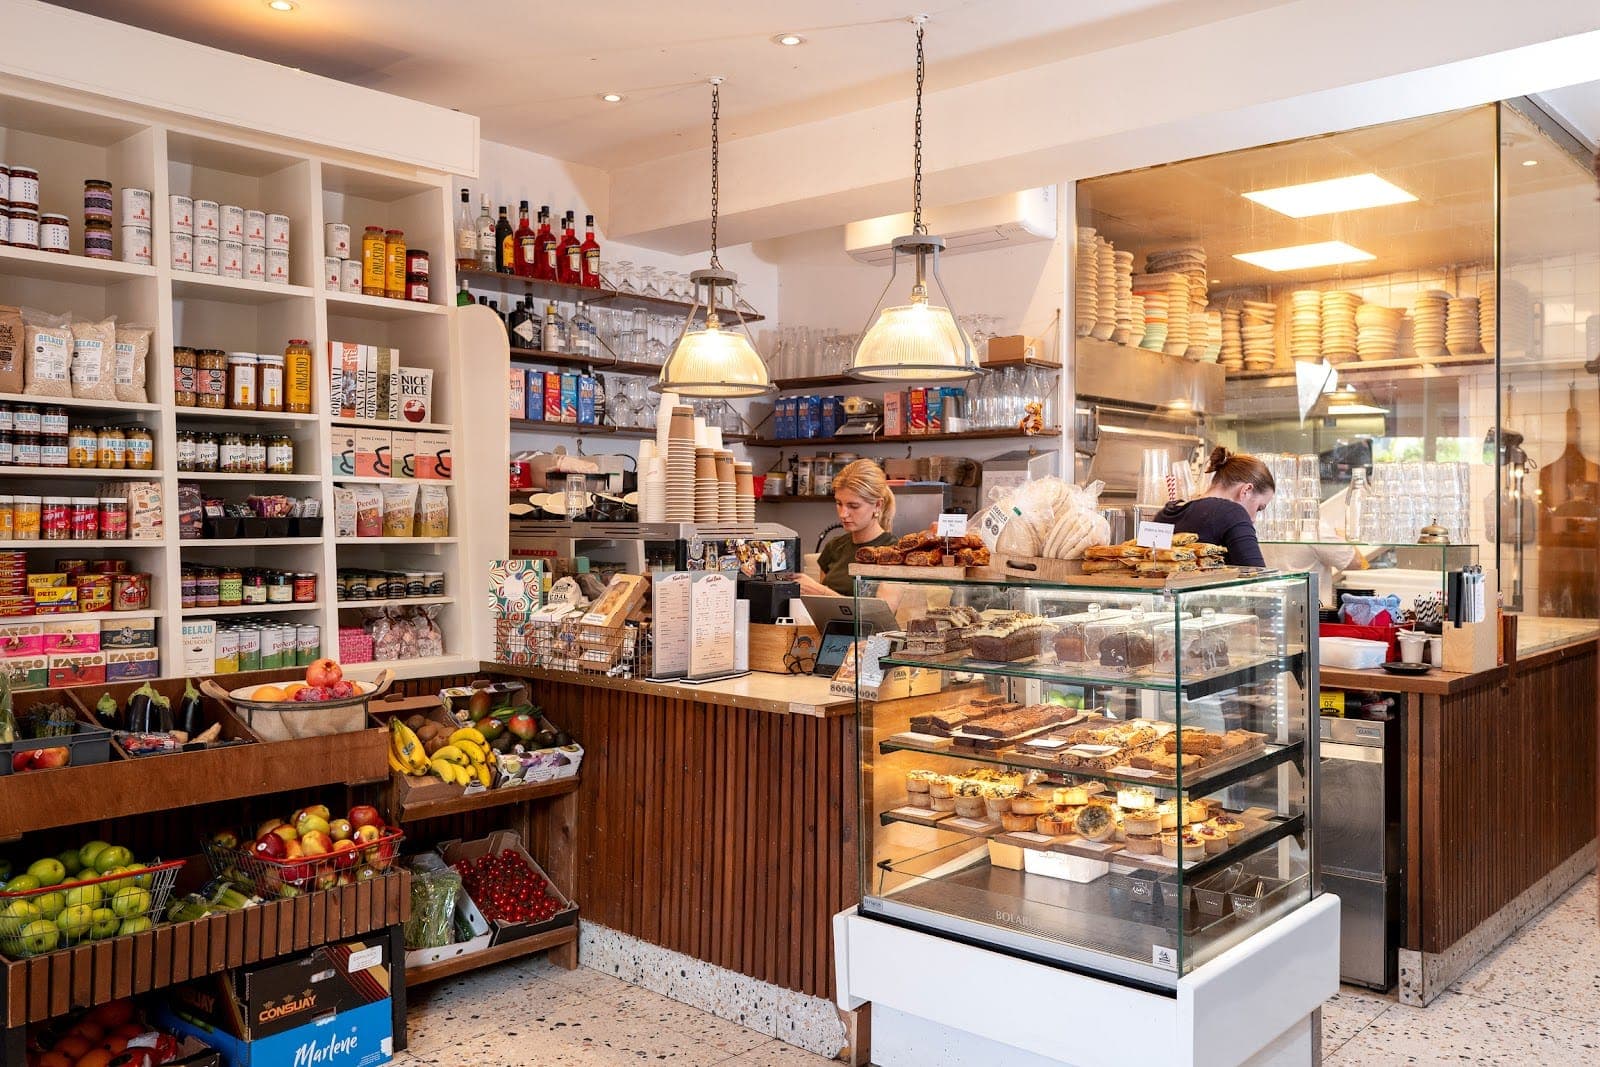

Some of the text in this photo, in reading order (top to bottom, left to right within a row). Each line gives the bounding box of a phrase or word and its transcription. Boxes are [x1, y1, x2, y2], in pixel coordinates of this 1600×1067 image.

[38, 334, 64, 346] BELAZU
[115, 344, 133, 352] LAZU
[401, 375, 426, 386] NICE
[402, 385, 427, 395] RICE
[0, 626, 41, 636] ATSO
[182, 624, 213, 635] BELAZU
[53, 655, 103, 668] FATSO
[110, 651, 155, 662] FATSO
[258, 994, 317, 1022] CONSUAY
[294, 1032, 358, 1067] Marlene
